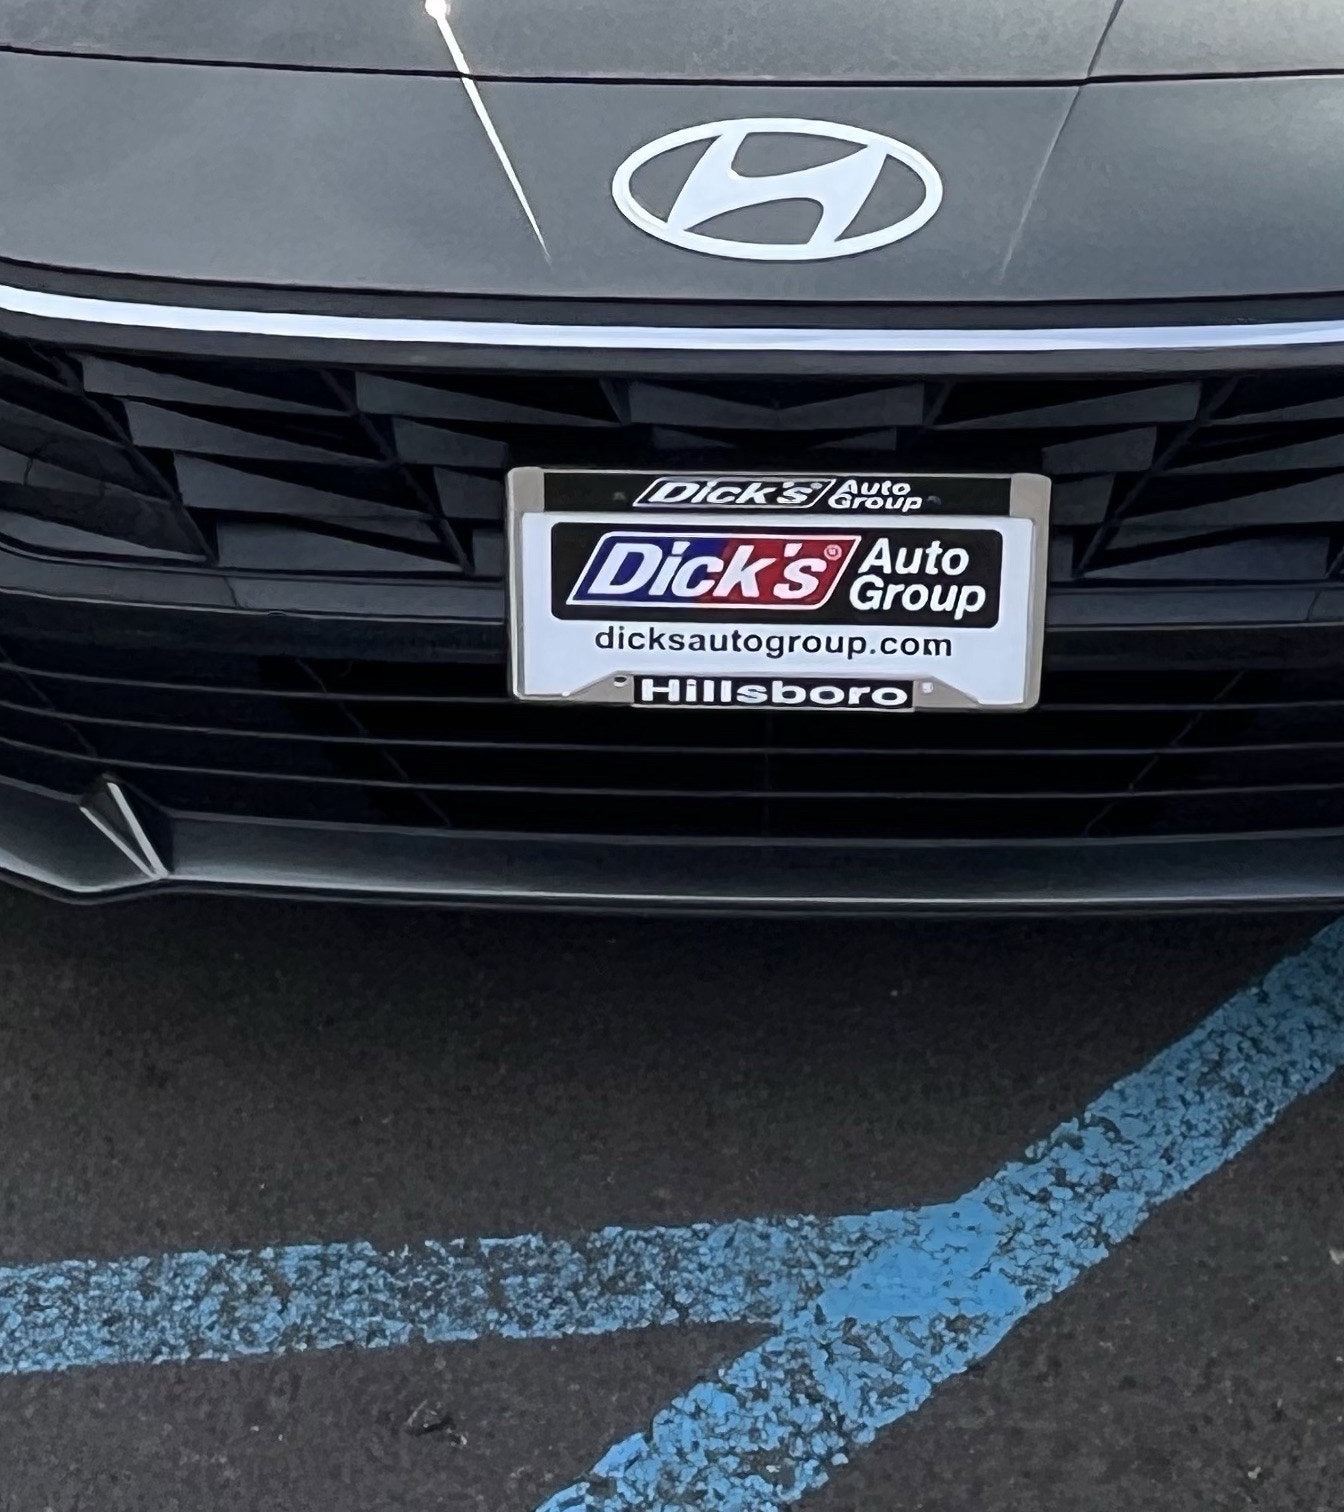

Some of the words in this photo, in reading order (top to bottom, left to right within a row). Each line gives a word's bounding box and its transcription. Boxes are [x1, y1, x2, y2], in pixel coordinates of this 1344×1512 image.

[827, 493, 924, 513] Group
[837, 478, 912, 497] Auto
[587, 540, 829, 600] Dick's
[856, 537, 970, 577] Auto
[848, 574, 987, 621] Group
[594, 624, 954, 660] dicksautogroup.com
[639, 677, 910, 708] Hillsboro
